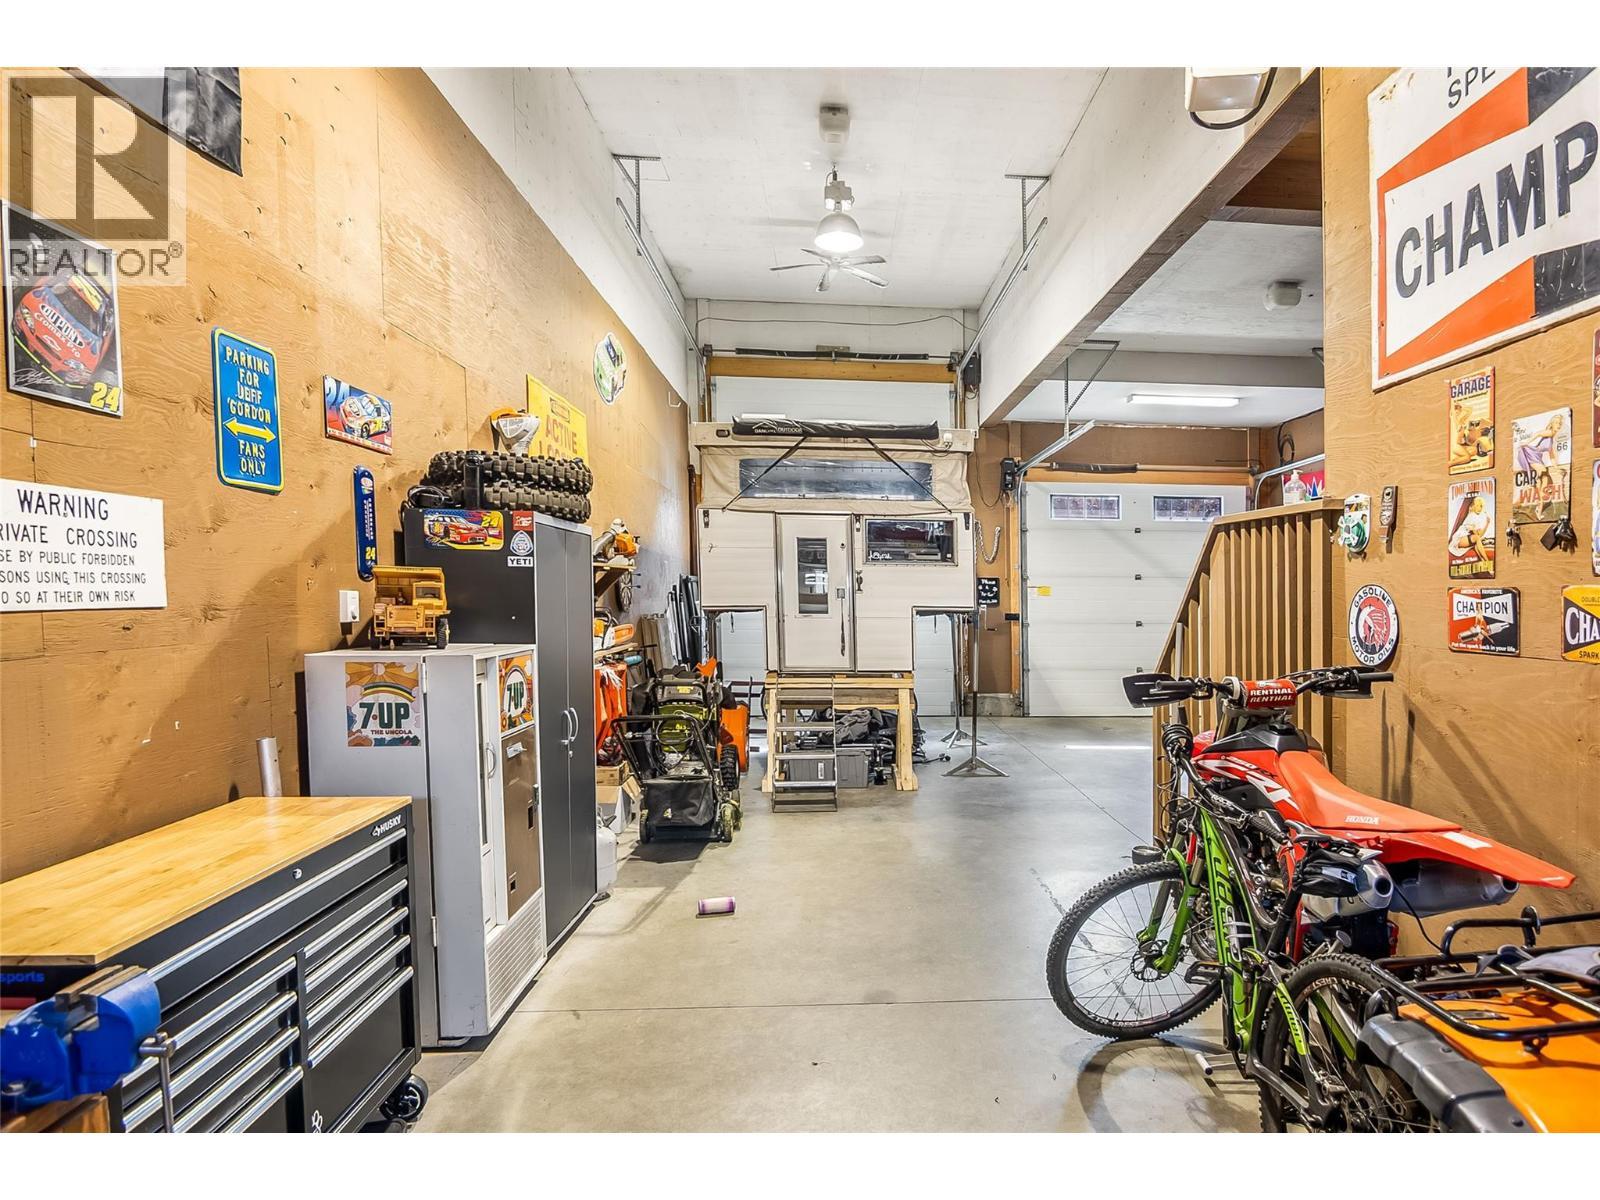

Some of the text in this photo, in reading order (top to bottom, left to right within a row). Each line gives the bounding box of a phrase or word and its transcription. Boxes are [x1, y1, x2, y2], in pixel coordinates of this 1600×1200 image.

[43, 305, 82, 346] DUPONT
[225, 346, 271, 376] PARKING
[238, 367, 260, 388] FOR
[1450, 375, 1491, 399] GARAGE
[90, 382, 120, 412] 24
[236, 382, 263, 405] JEFF
[228, 399, 272, 425] GORDON
[546, 415, 577, 455] ACTIVE
[238, 439, 266, 460] FANS
[1557, 442, 1568, 452] 66
[239, 458, 267, 477] ONLY
[1515, 470, 1537, 487] CAR
[1520, 484, 1561, 504] WASH
[17, 488, 109, 521] WARNING
[481, 516, 500, 527] 24
[66, 527, 138, 549] CROSSING
[19, 550, 33, 563] BY
[39, 551, 77, 565] PUBLIC
[82, 552, 135, 566] FORBIDDEN
[365, 546, 376, 561] 24
[509, 557, 532, 566] YETI
[36, 571, 69, 585] USING
[74, 571, 96, 584] THIS
[101, 572, 147, 584] CROSSING
[16, 591, 31, 604] SO
[37, 591, 48, 604] AT
[54, 590, 84, 603] THEIR
[88, 590, 110, 603] OWN
[114, 590, 136, 602] RISK
[1354, 586, 1392, 608] GASOLINE
[1351, 635, 1394, 665] MOTOR OILS
[1579, 650, 1600, 660] SPARK
[1249, 695, 1293, 704] RENTHAL
[1250, 688, 1294, 696] RENTHAL
[380, 814, 402, 834] HUSKY
[1344, 815, 1381, 826] HONDA
